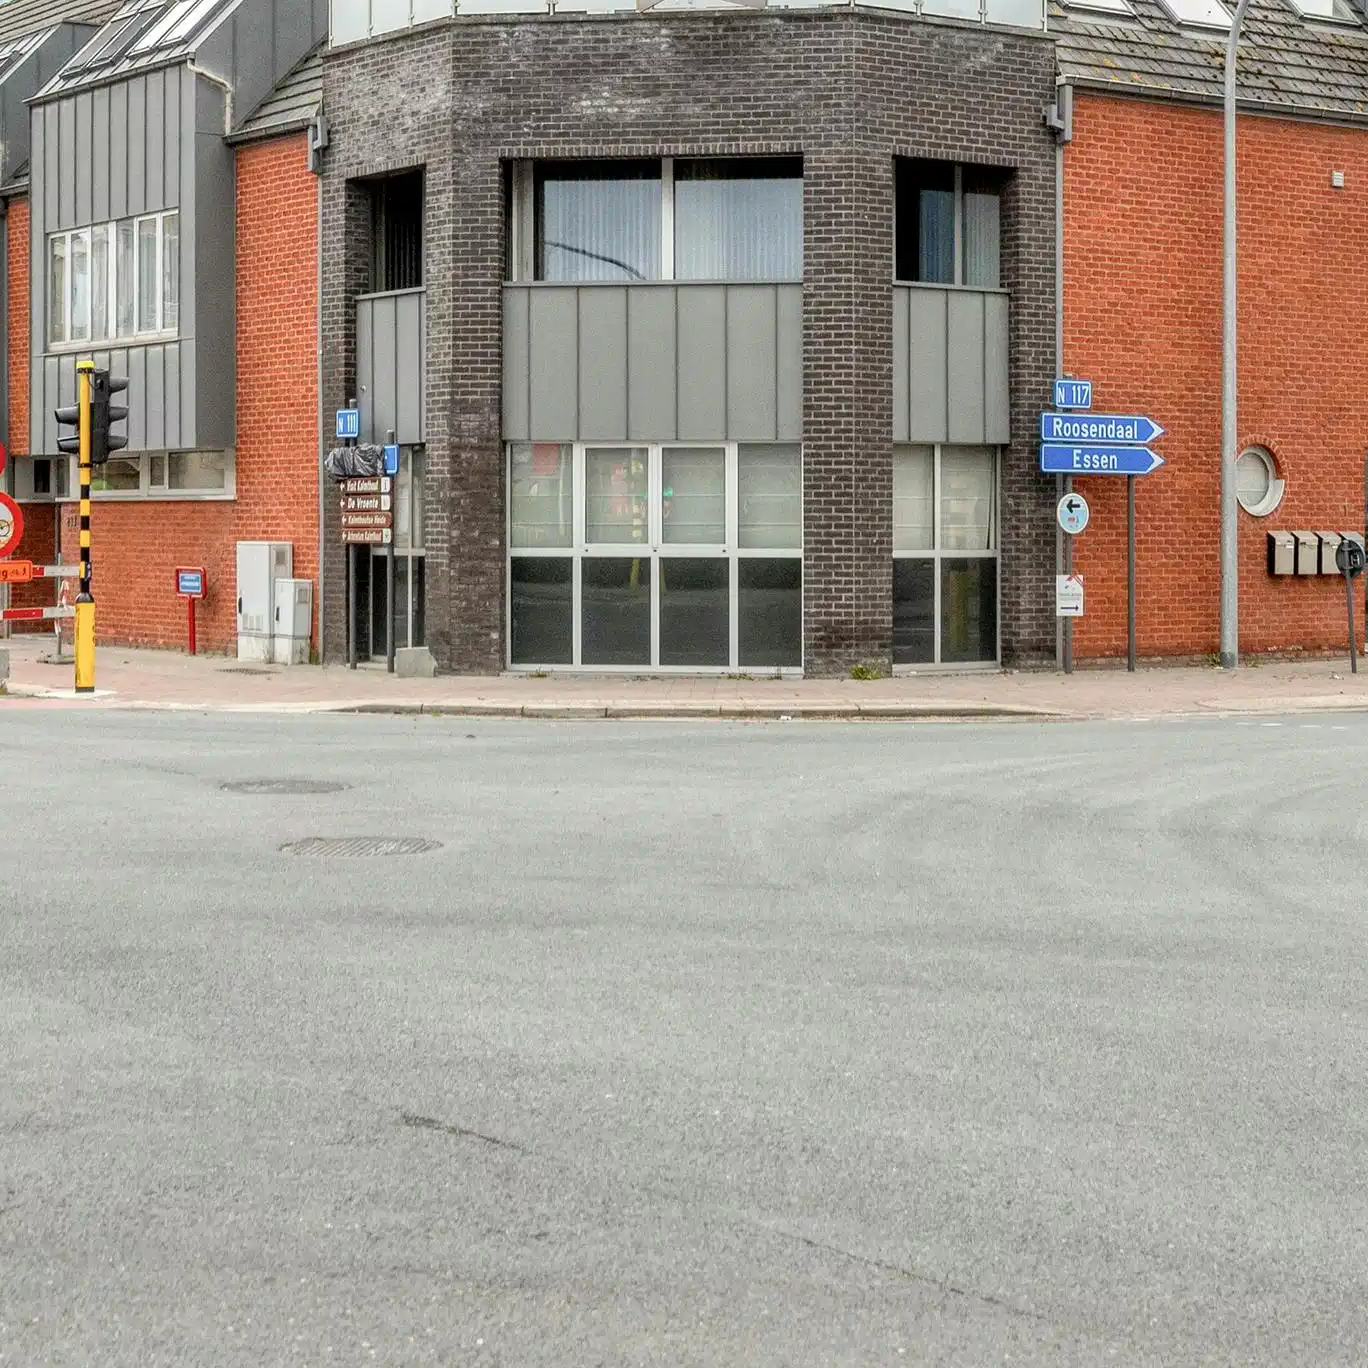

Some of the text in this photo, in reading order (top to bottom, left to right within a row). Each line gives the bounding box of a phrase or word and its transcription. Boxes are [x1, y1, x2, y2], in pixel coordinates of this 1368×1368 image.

[1058, 385, 1089, 405] N 117
[338, 417, 344, 432] N
[1053, 417, 1138, 440] Roosendaal
[1073, 449, 1118, 470] Essen
